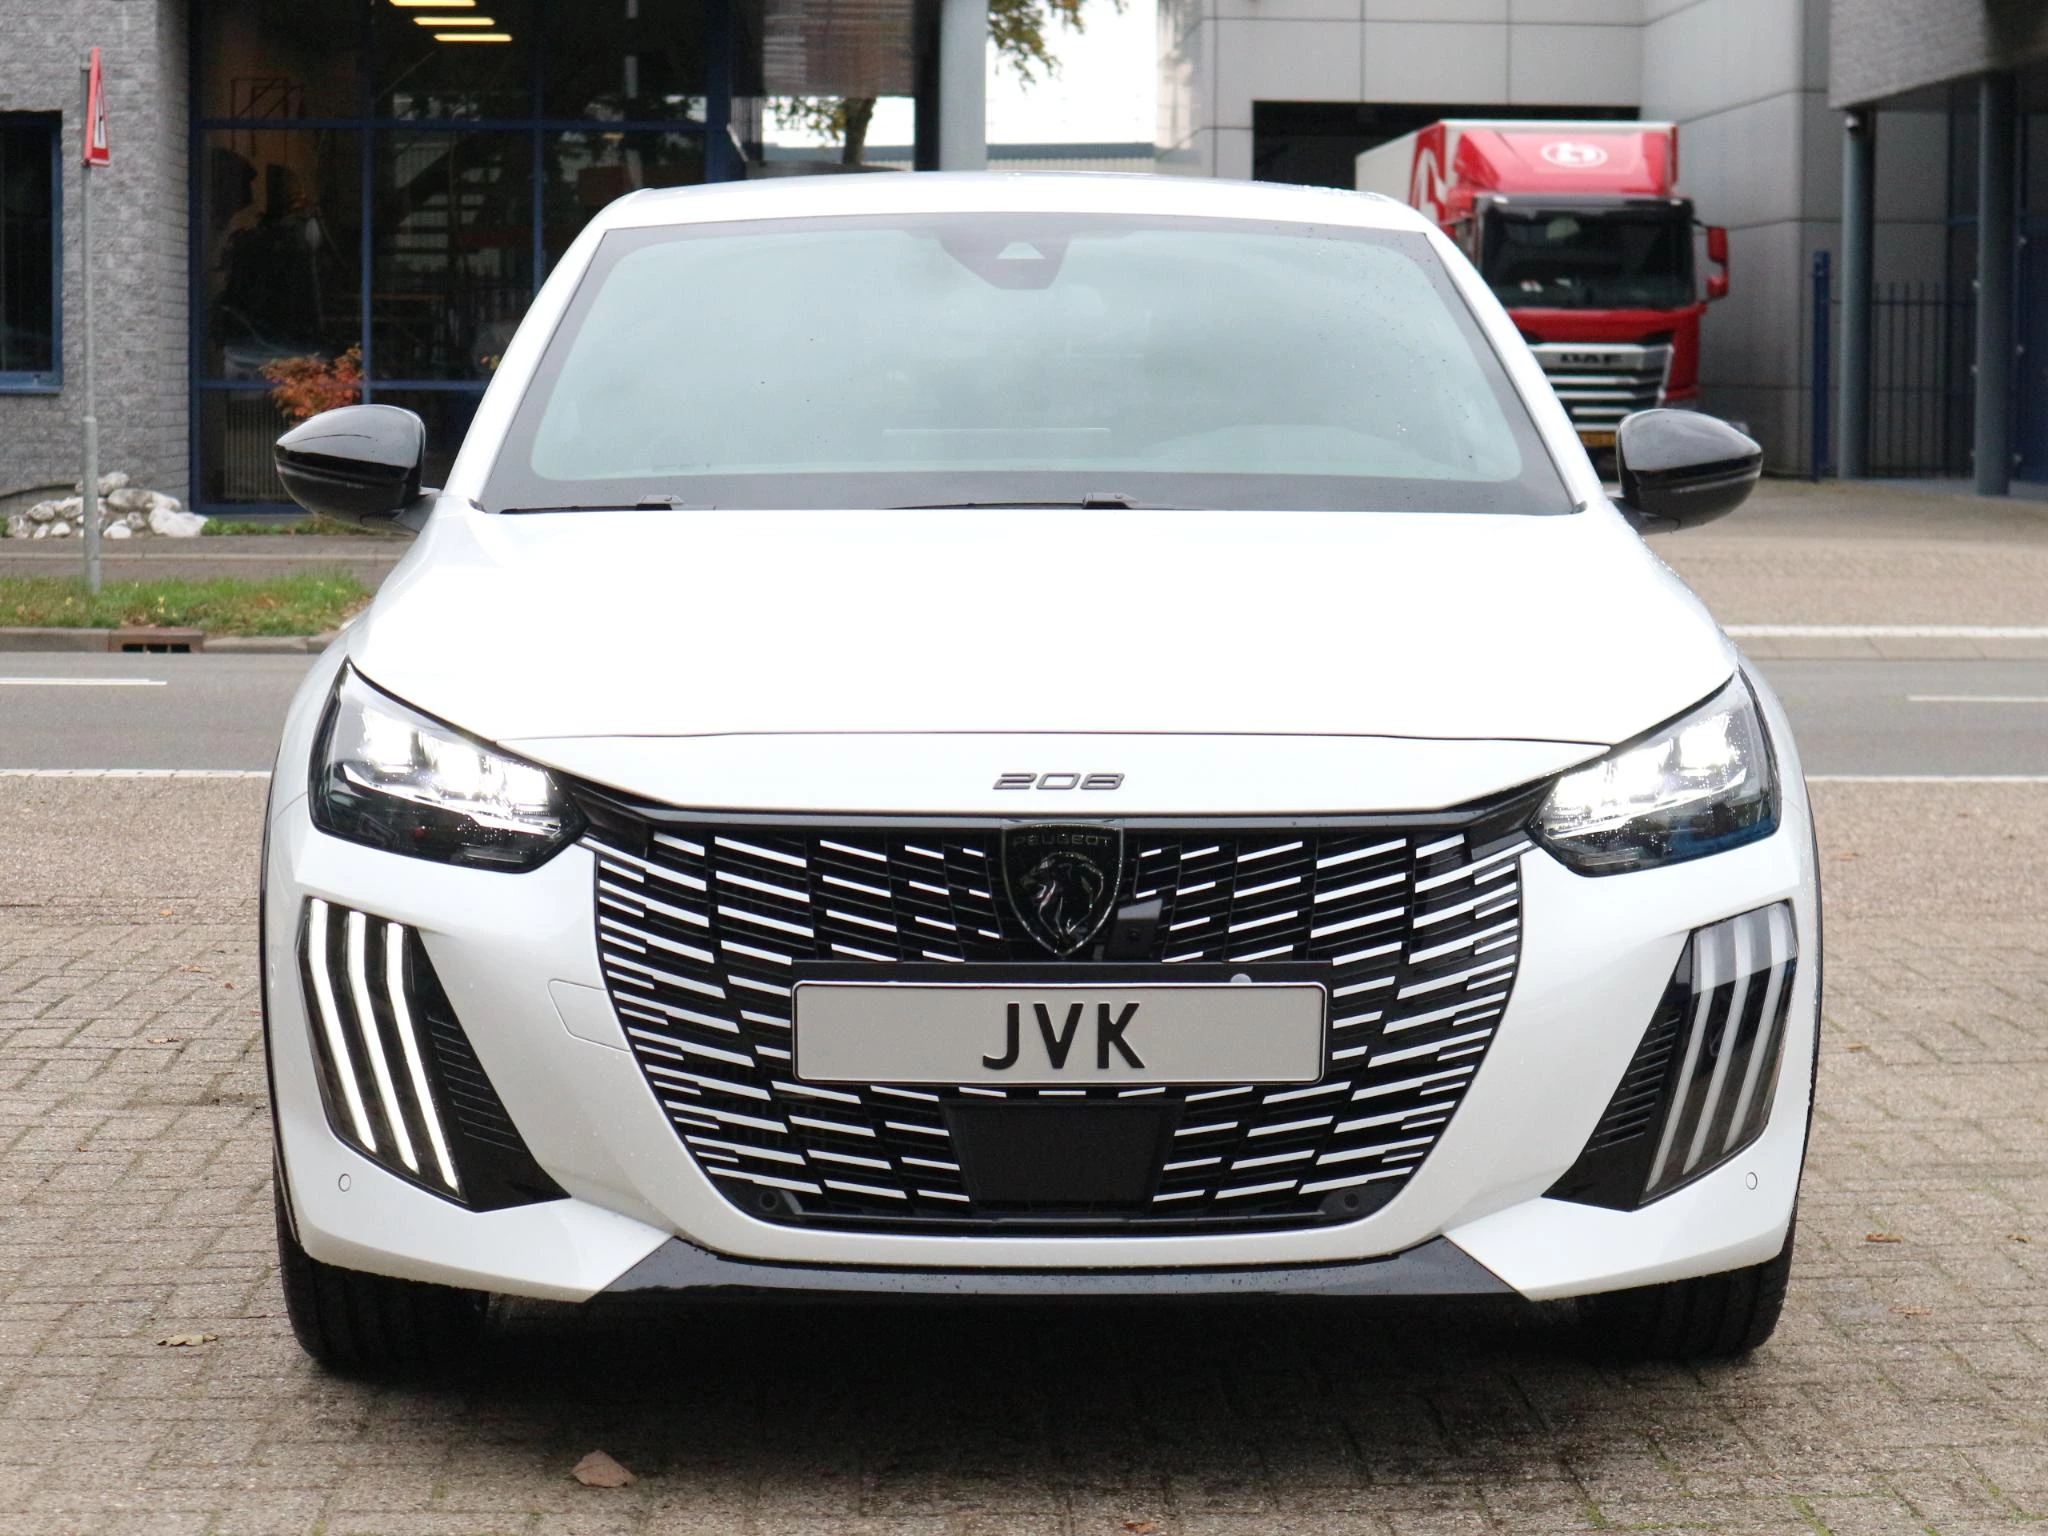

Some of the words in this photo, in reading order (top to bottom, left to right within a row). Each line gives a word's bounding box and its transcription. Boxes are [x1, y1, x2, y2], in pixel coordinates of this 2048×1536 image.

[1560, 352, 1622, 365] DAF
[993, 772, 1125, 790] 208
[1012, 834, 1112, 847] PEUGEOT
[982, 1002, 1145, 1070] JVK
